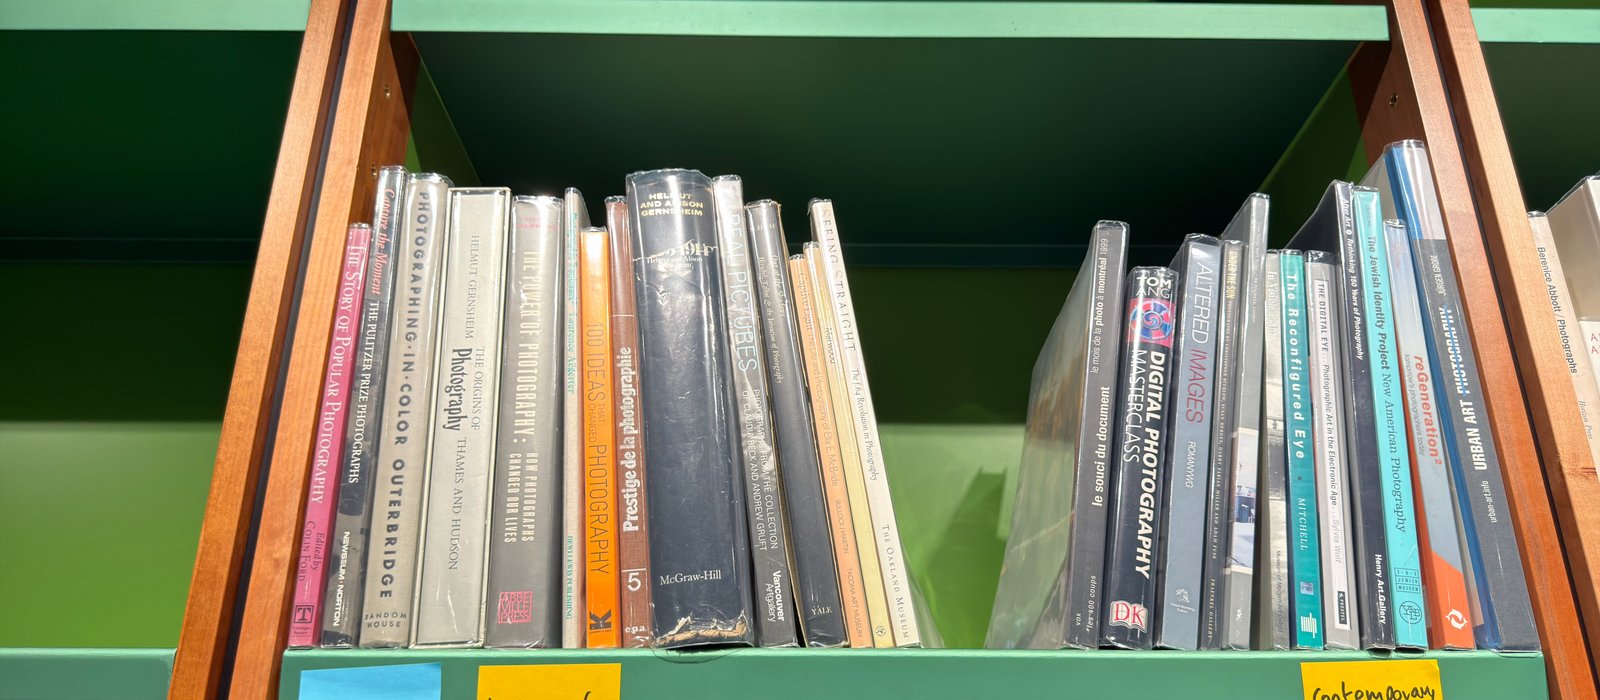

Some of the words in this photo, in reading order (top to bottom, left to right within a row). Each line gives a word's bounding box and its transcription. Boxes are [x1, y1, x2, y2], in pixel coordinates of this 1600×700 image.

[380, 188, 395, 230] Capture
[347, 243, 366, 268] THE
[375, 231, 390, 249] the
[469, 235, 480, 277] HELMUT
[1100, 238, 1109, 255] 1999
[1368, 236, 1377, 253] The
[370, 251, 388, 296] Moment
[523, 251, 542, 273] THE
[1097, 255, 1108, 294] montréal
[1227, 251, 1238, 271] UNDER
[1370, 256, 1381, 288] Jewish
[341, 270, 363, 313] STORY
[824, 209, 839, 264] SEEING
[836, 270, 857, 352] STRAIGHT
[1136, 276, 1172, 290] TOM
[1136, 287, 1171, 299] ANG
[1225, 285, 1236, 298] SUN
[1226, 272, 1236, 284] THE
[1286, 273, 1297, 300] The
[1317, 283, 1325, 298] THE
[369, 302, 381, 322] THE
[465, 280, 478, 339] GERNSHEIM
[519, 275, 542, 320] POWER
[1094, 301, 1104, 326] photo
[1191, 262, 1215, 344] ALTERED
[1346, 238, 1356, 272] Rethinking
[1354, 316, 1364, 360] Photography
[1373, 290, 1385, 330] Identity
[1537, 246, 1552, 283] Berenice
[1547, 284, 1562, 314] Abbott
[1557, 318, 1578, 374] Photographs
[336, 315, 351, 333] OF
[519, 321, 540, 335] OF
[728, 272, 758, 372] PICTURES
[1318, 300, 1327, 333] DIGITAL
[362, 323, 378, 372] PULITZER
[586, 322, 604, 347] 100
[826, 327, 836, 364] Marwood
[1320, 336, 1328, 352] EYE
[1438, 305, 1470, 394] PHOTOGRAPHY
[326, 334, 351, 398] POPULAR
[475, 346, 485, 368] THE
[772, 350, 782, 383] Photography
[1092, 346, 1101, 364] mois
[1288, 308, 1305, 420] Reconfigured
[1376, 333, 1389, 370] Project
[586, 353, 606, 402] IDEAS
[1091, 365, 1099, 374] le
[1382, 373, 1392, 397] New
[358, 373, 371, 400] PRIZE
[442, 347, 473, 432] Photography
[472, 370, 484, 413] ORIGINS
[620, 346, 638, 434] photographie
[741, 390, 750, 400] OF
[1145, 350, 1166, 423] DIGITAL
[1186, 348, 1208, 424] IMAGES
[1321, 364, 1332, 412] Photographic
[598, 402, 606, 422] THAT
[743, 403, 753, 437] CLAUDIA
[753, 388, 766, 448] PHOTOGRAPHS
[1098, 386, 1110, 442] document
[1124, 350, 1148, 463] MASTERCLASS
[1325, 413, 1333, 425] Art
[1408, 388, 1422, 436] photographers
[1416, 436, 1425, 456] today
[1460, 400, 1479, 425] ART
[1578, 400, 1590, 424] Horizon
[472, 416, 482, 431] OF
[588, 404, 598, 442] CHANGED
[856, 396, 870, 432] Revolution
[866, 438, 880, 481] Photography
[1384, 400, 1397, 454] American
[312, 400, 342, 504] PHOTOGRAPHY
[349, 404, 368, 484] PHOTOGRAPHS
[618, 436, 635, 449] la
[747, 440, 756, 461] BECK
[1097, 444, 1107, 458] du
[1294, 430, 1306, 460] Eye
[1326, 435, 1335, 448] the
[1468, 427, 1488, 471] URBAN
[455, 437, 468, 484] THAMES
[507, 453, 522, 494] CHANGED
[526, 452, 539, 472] HOW
[619, 450, 636, 469] de
[749, 462, 758, 480] AND
[759, 450, 769, 474] FROM
[827, 454, 838, 486] McBride
[1326, 450, 1339, 489] Electronic
[622, 450, 640, 532] Prestige
[762, 476, 771, 492] THE
[1094, 461, 1106, 492] souci
[453, 488, 462, 514] AND
[506, 496, 520, 514] OUR
[521, 475, 538, 542] PHOTOGRAPHS
[589, 444, 610, 575] PHOTOGRAPHY
[751, 482, 763, 521] ANDREW
[1092, 494, 1103, 506] le
[1136, 428, 1160, 579] PHOTOGRAPHY
[1329, 490, 1339, 506] Age
[1390, 458, 1407, 533] Photography
[1480, 480, 1498, 524] urban-art.info
[304, 521, 316, 552] COLIN
[380, 458, 406, 598] OUTERBRIDGE
[504, 516, 518, 544] LIVES
[756, 522, 767, 551] GRUFT
[764, 494, 778, 549] COLLECTION
[882, 524, 891, 543] THE
[1297, 498, 1309, 551] MITCHELL
[1330, 518, 1340, 543] Sylvia
[314, 532, 326, 557] Edited
[448, 519, 462, 570] HUDSON
[1333, 544, 1342, 563] Wolf
[298, 555, 310, 581] FORD
[628, 572, 641, 592] 5
[660, 569, 722, 586] McGraw-Hill
[886, 548, 900, 594] OAKLAND
[765, 582, 776, 622] Artgallery
[772, 570, 785, 622] Vancouver
[846, 568, 856, 596] TACOMA
[854, 608, 863, 636] MUSEUM
[1088, 575, 1097, 598] coups
[1374, 554, 1382, 577] Henry
[1378, 594, 1387, 624] Gallery
[367, 620, 402, 630] HOUSE
[498, 611, 532, 622] PRESS
[812, 606, 832, 616] YALE
[896, 598, 910, 639] MUSEUM
[1115, 602, 1145, 628] DK
[1206, 611, 1214, 639] GALLERY
